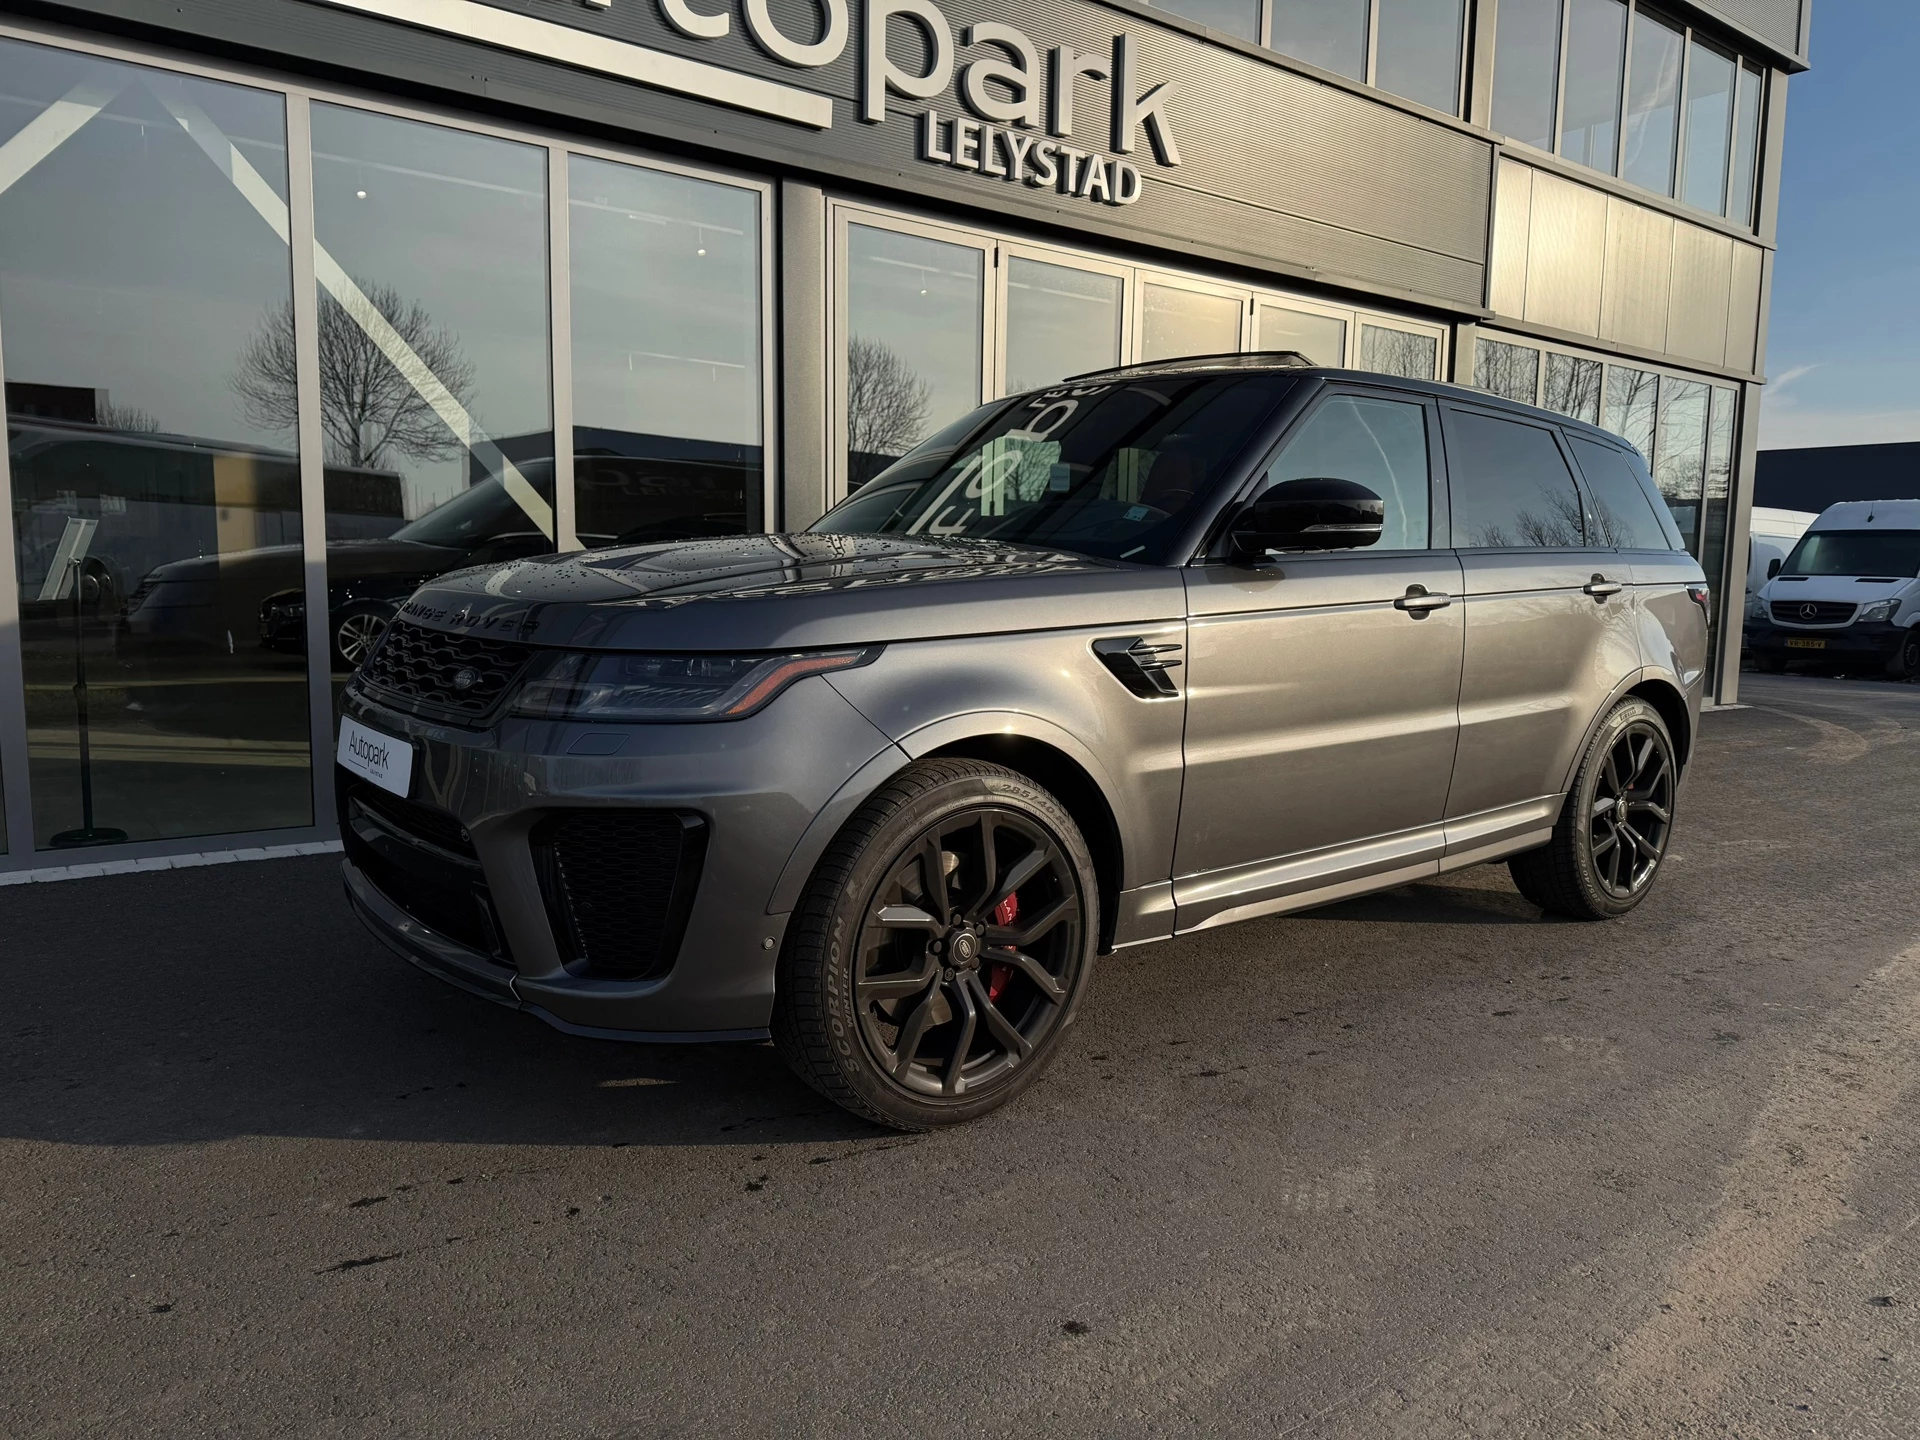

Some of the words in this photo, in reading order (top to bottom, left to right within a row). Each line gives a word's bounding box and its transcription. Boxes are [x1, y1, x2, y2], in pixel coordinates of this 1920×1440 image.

[587, 0, 1182, 167] opark
[924, 110, 1142, 206] LELYSTAD
[402, 601, 447, 622] RANGE
[449, 613, 540, 635] ROVER
[348, 729, 390, 771] Autopark
[827, 915, 861, 1073] SCORPION
[842, 967, 854, 1028] WINTER
